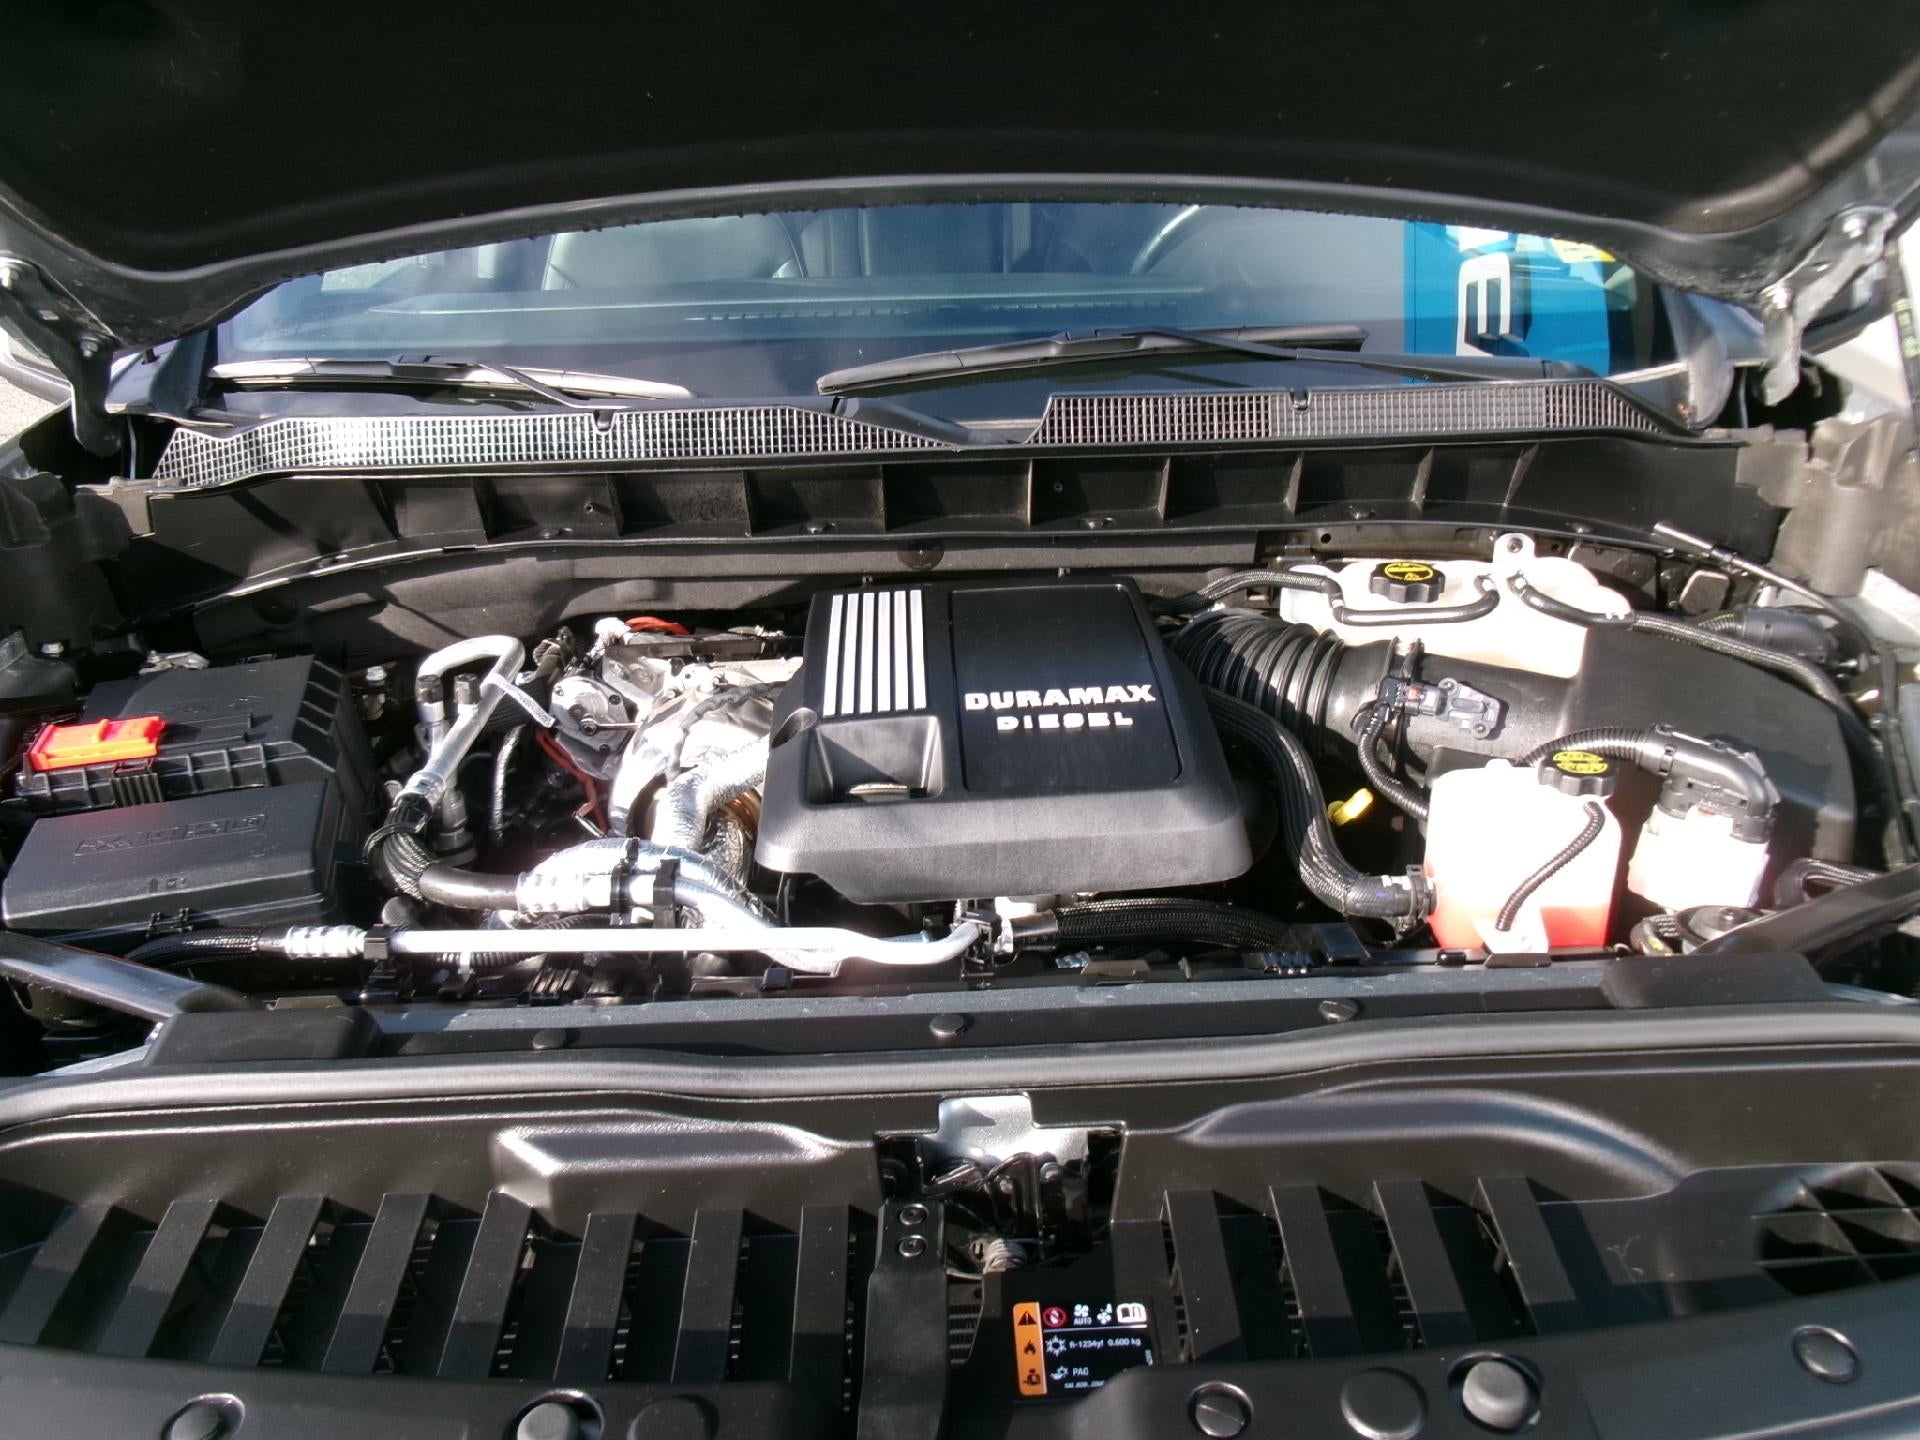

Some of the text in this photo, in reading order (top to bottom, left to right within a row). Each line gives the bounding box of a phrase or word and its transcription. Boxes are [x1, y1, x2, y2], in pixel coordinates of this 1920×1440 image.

[964, 684, 1157, 710] DURAMAX
[996, 711, 1134, 731] DIESEL
[1074, 1317, 1092, 1326] AUTO
[1107, 1338, 1129, 1347] 0.600
[1072, 1367, 1089, 1377] PAG
